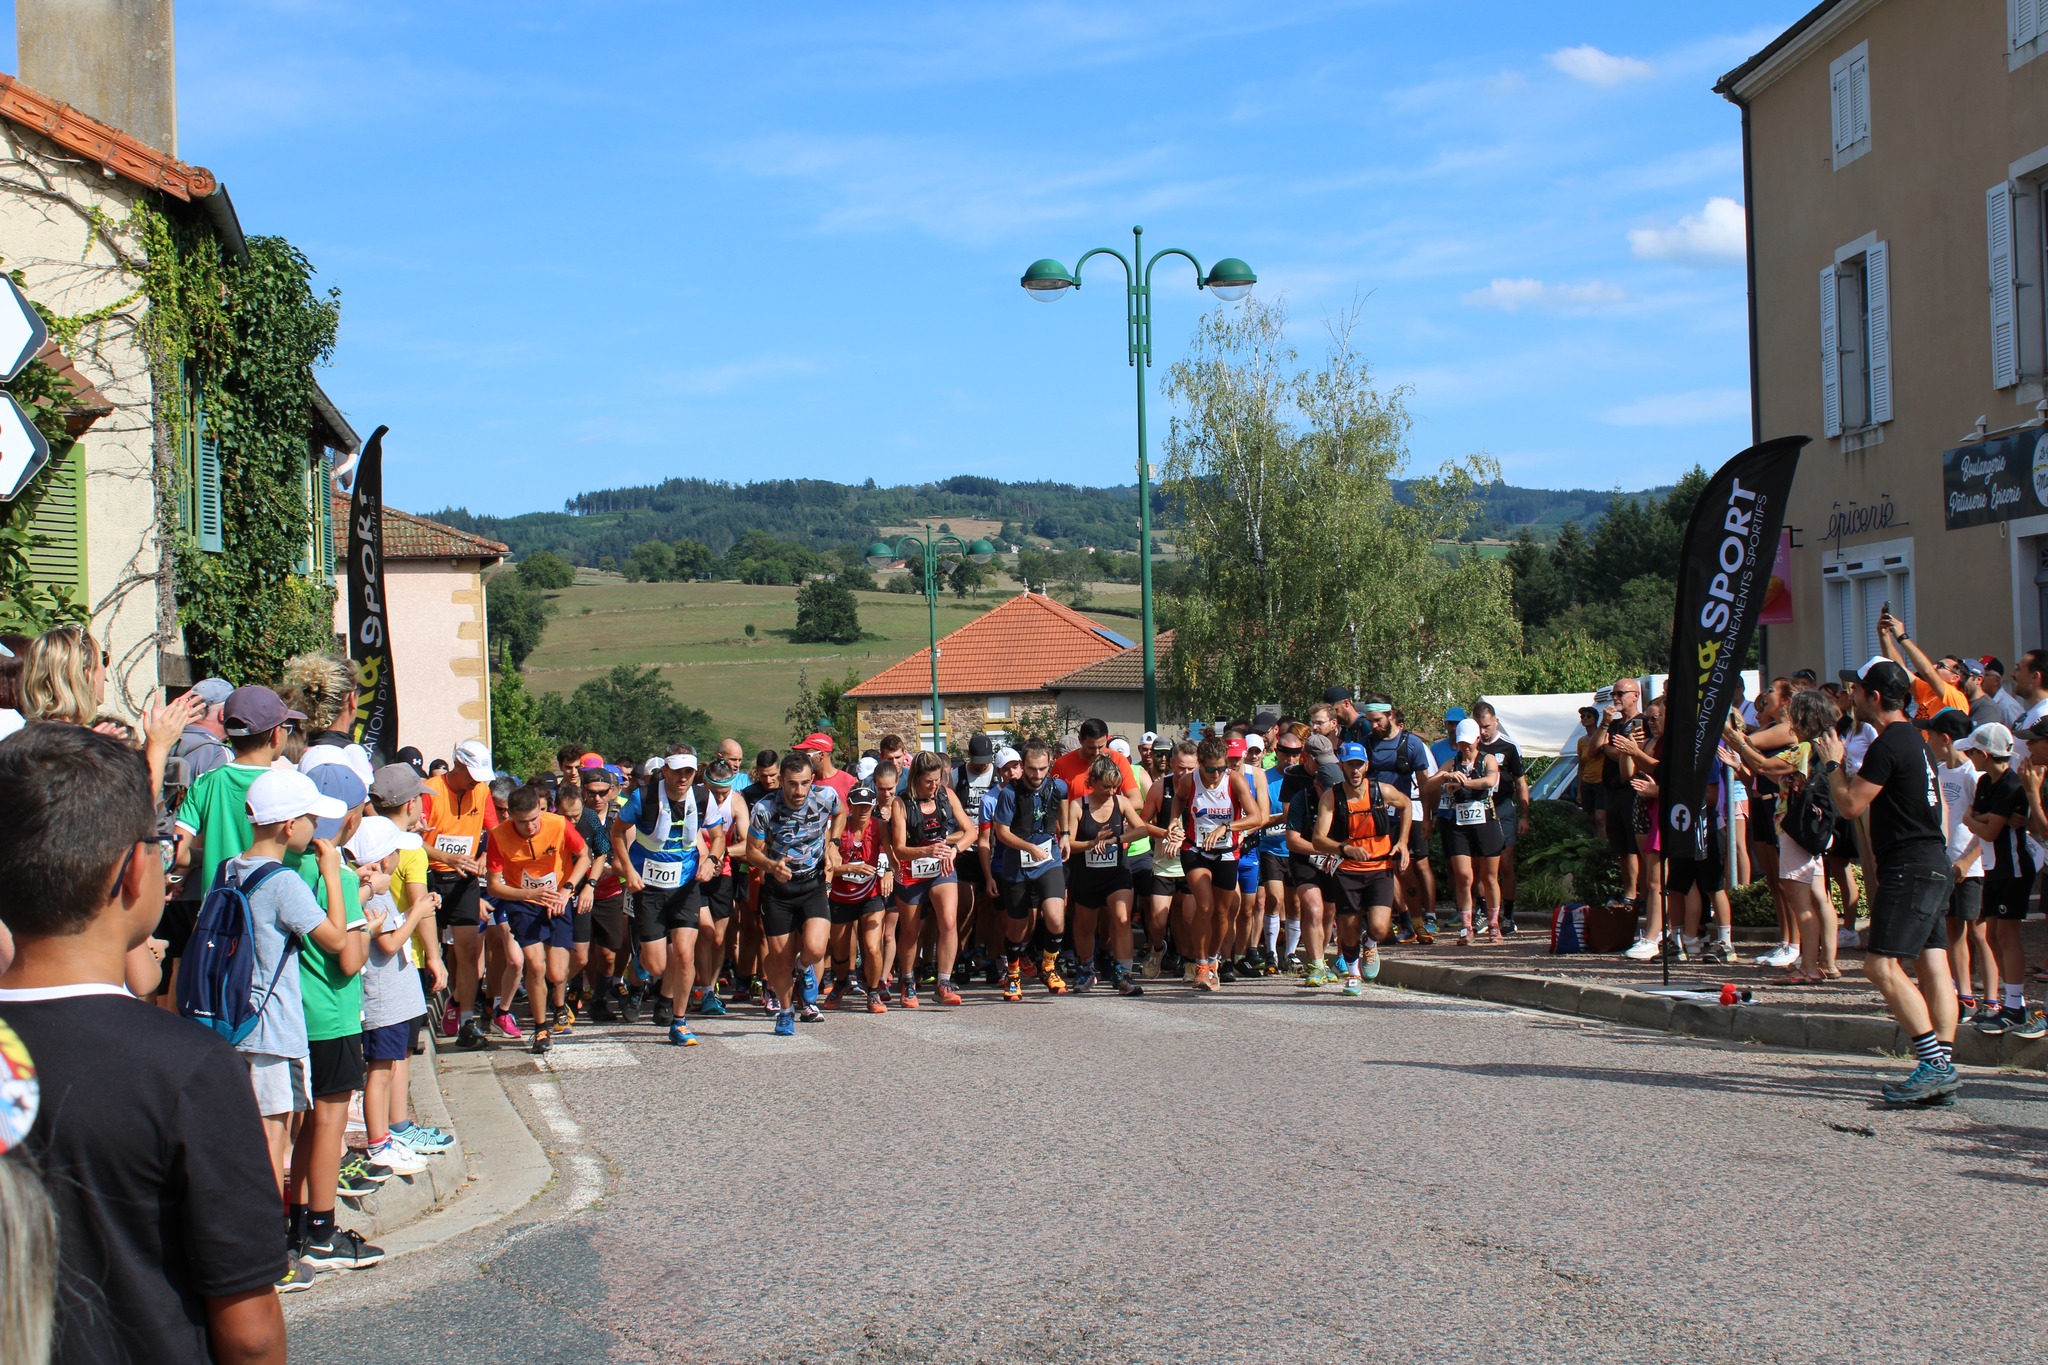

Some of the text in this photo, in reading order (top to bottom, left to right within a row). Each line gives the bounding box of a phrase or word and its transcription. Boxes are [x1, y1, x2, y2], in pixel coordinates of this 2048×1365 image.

[1961, 455, 2006, 485] Boulangerie
[1746, 494, 1767, 567] SPORTIFS
[1817, 493, 1909, 559] épicerie
[1701, 477, 1756, 633] SPORT
[357, 487, 383, 648] SPORT
[1208, 807, 1232, 815] INTER
[1459, 808, 1482, 820] 1972
[439, 843, 467, 855] 1696
[648, 868, 676, 882] 1701
[916, 861, 940, 874] 1747
